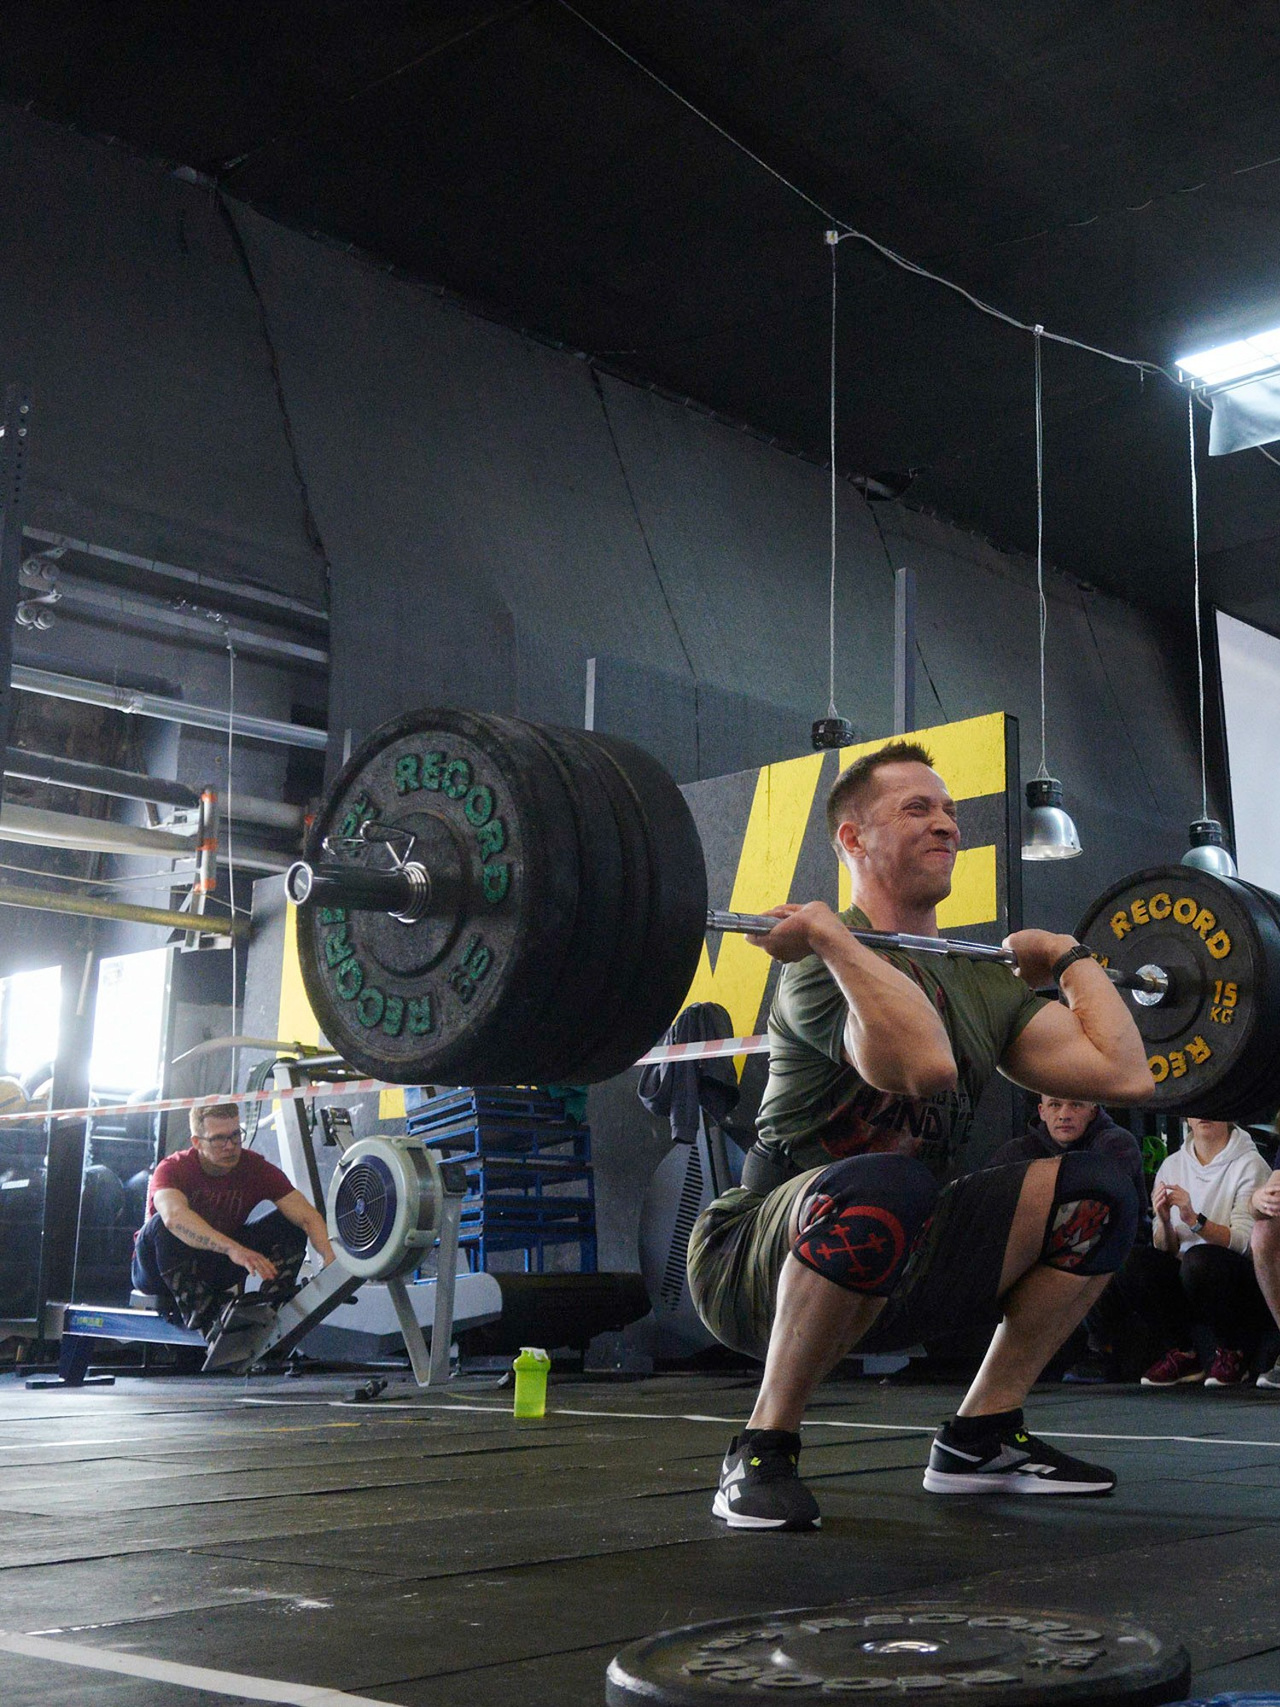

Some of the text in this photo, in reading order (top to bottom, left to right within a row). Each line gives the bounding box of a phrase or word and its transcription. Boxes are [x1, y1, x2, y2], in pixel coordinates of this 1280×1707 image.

[395, 751, 511, 902] RECORD
[1110, 892, 1232, 960] RECORD
[1213, 979, 1238, 1008] 15
[1209, 1006, 1236, 1025] KG
[800, 1613, 1105, 1643] RECORD
